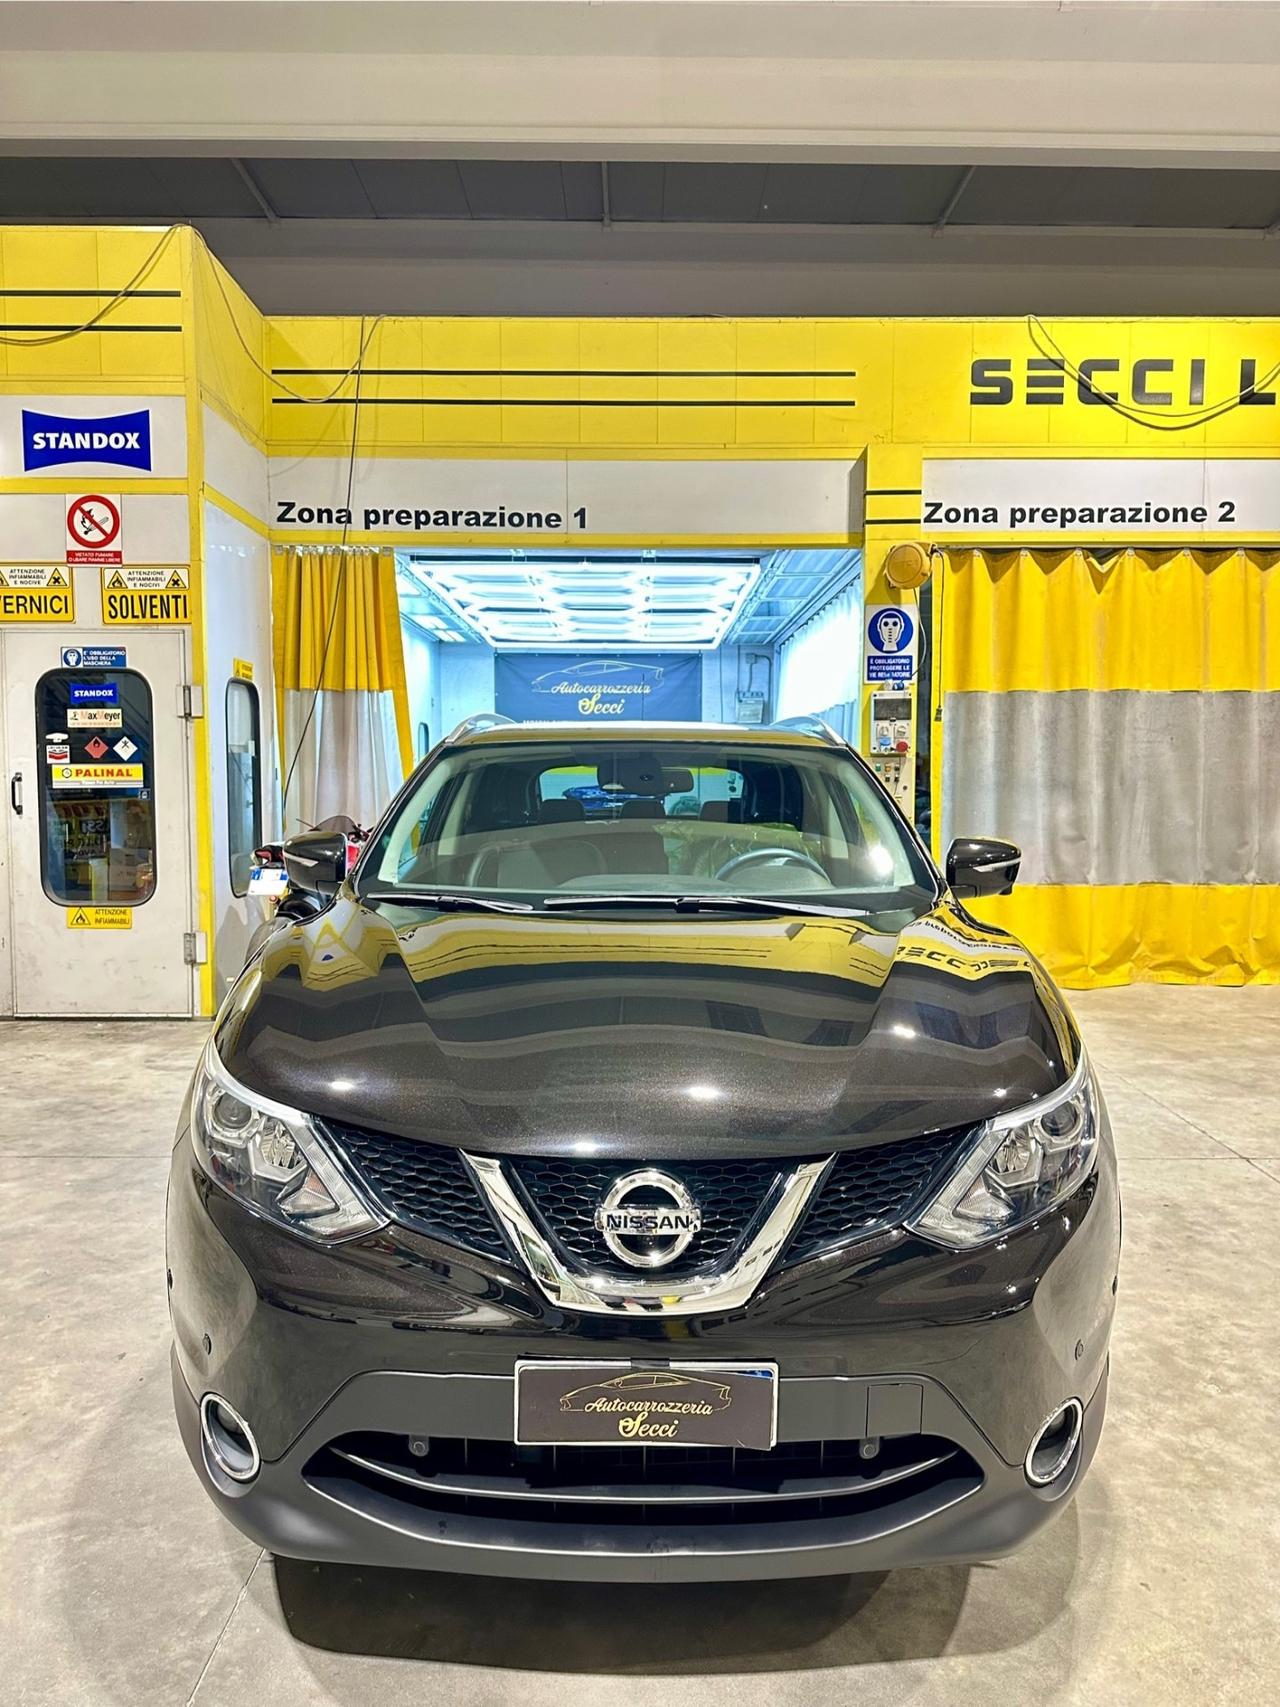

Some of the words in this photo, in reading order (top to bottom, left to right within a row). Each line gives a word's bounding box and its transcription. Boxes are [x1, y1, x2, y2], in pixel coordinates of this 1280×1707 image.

[969, 359, 1206, 405] SECCI
[1239, 359, 1277, 405] L
[33, 432, 141, 449] STANDOX
[276, 501, 352, 525] Zona
[363, 506, 562, 530] preparazione
[573, 507, 587, 529] 1
[923, 502, 999, 524] Zona
[1010, 502, 1208, 528] preparazione
[1218, 502, 1236, 523] 2
[0, 595, 69, 614] ERNICI
[108, 594, 188, 619] SOLVENTI
[74, 689, 114, 697] STANDOX
[551, 681, 651, 694] Autocarrozzeria
[577, 694, 625, 715] Secci
[80, 711, 121, 721] MaxMeyer
[75, 769, 133, 777] PALINAL
[606, 1215, 690, 1230] NISSAN
[584, 1398, 713, 1415] Autocarrozzeria
[618, 1411, 679, 1438] Secci
